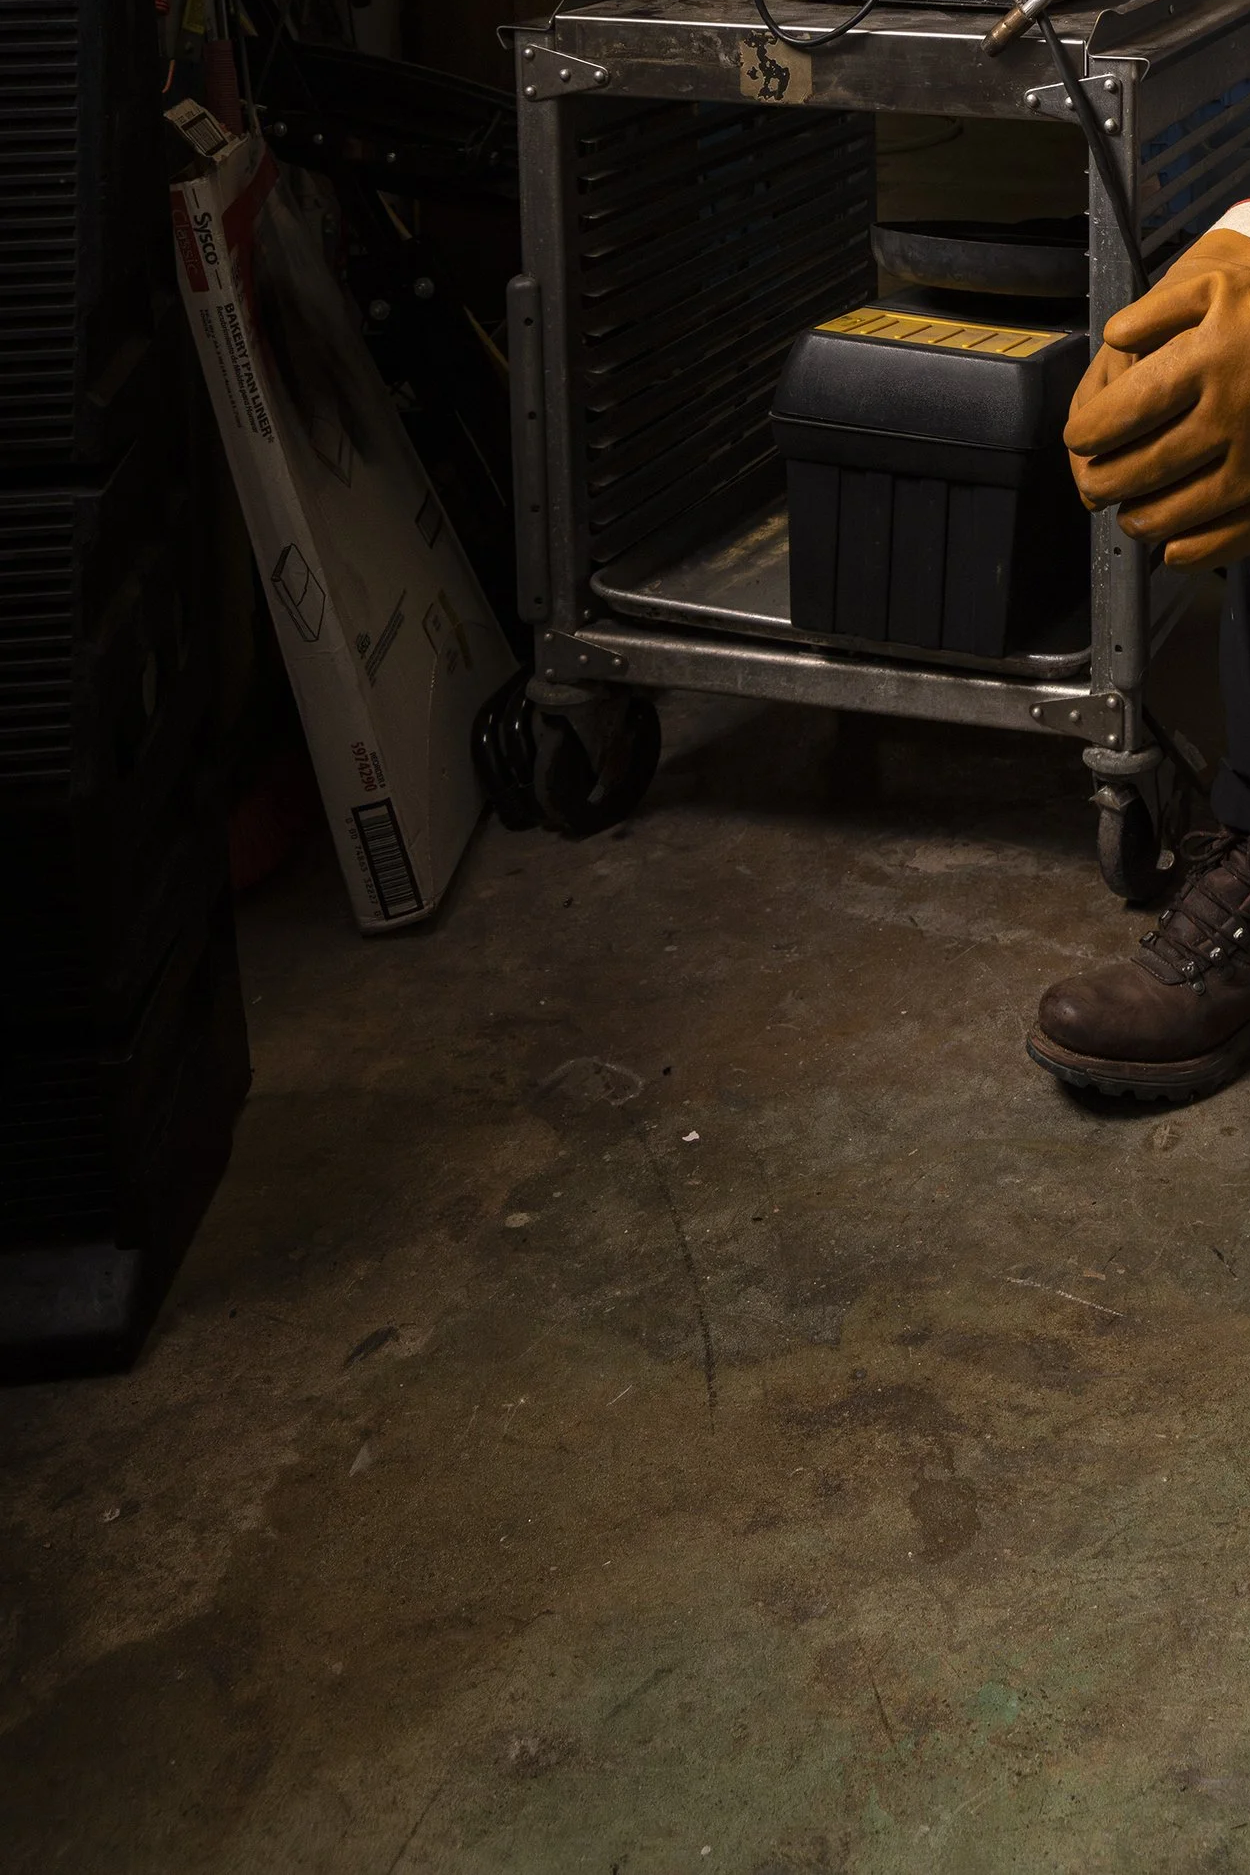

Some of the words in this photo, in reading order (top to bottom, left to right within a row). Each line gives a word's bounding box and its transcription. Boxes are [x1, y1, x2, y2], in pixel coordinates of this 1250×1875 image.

[193, 212, 218, 266] Sysco
[223, 303, 248, 359] BAKERY
[241, 362, 259, 394] PAN
[252, 395, 272, 436] LINER
[351, 741, 376, 792] 5974290
